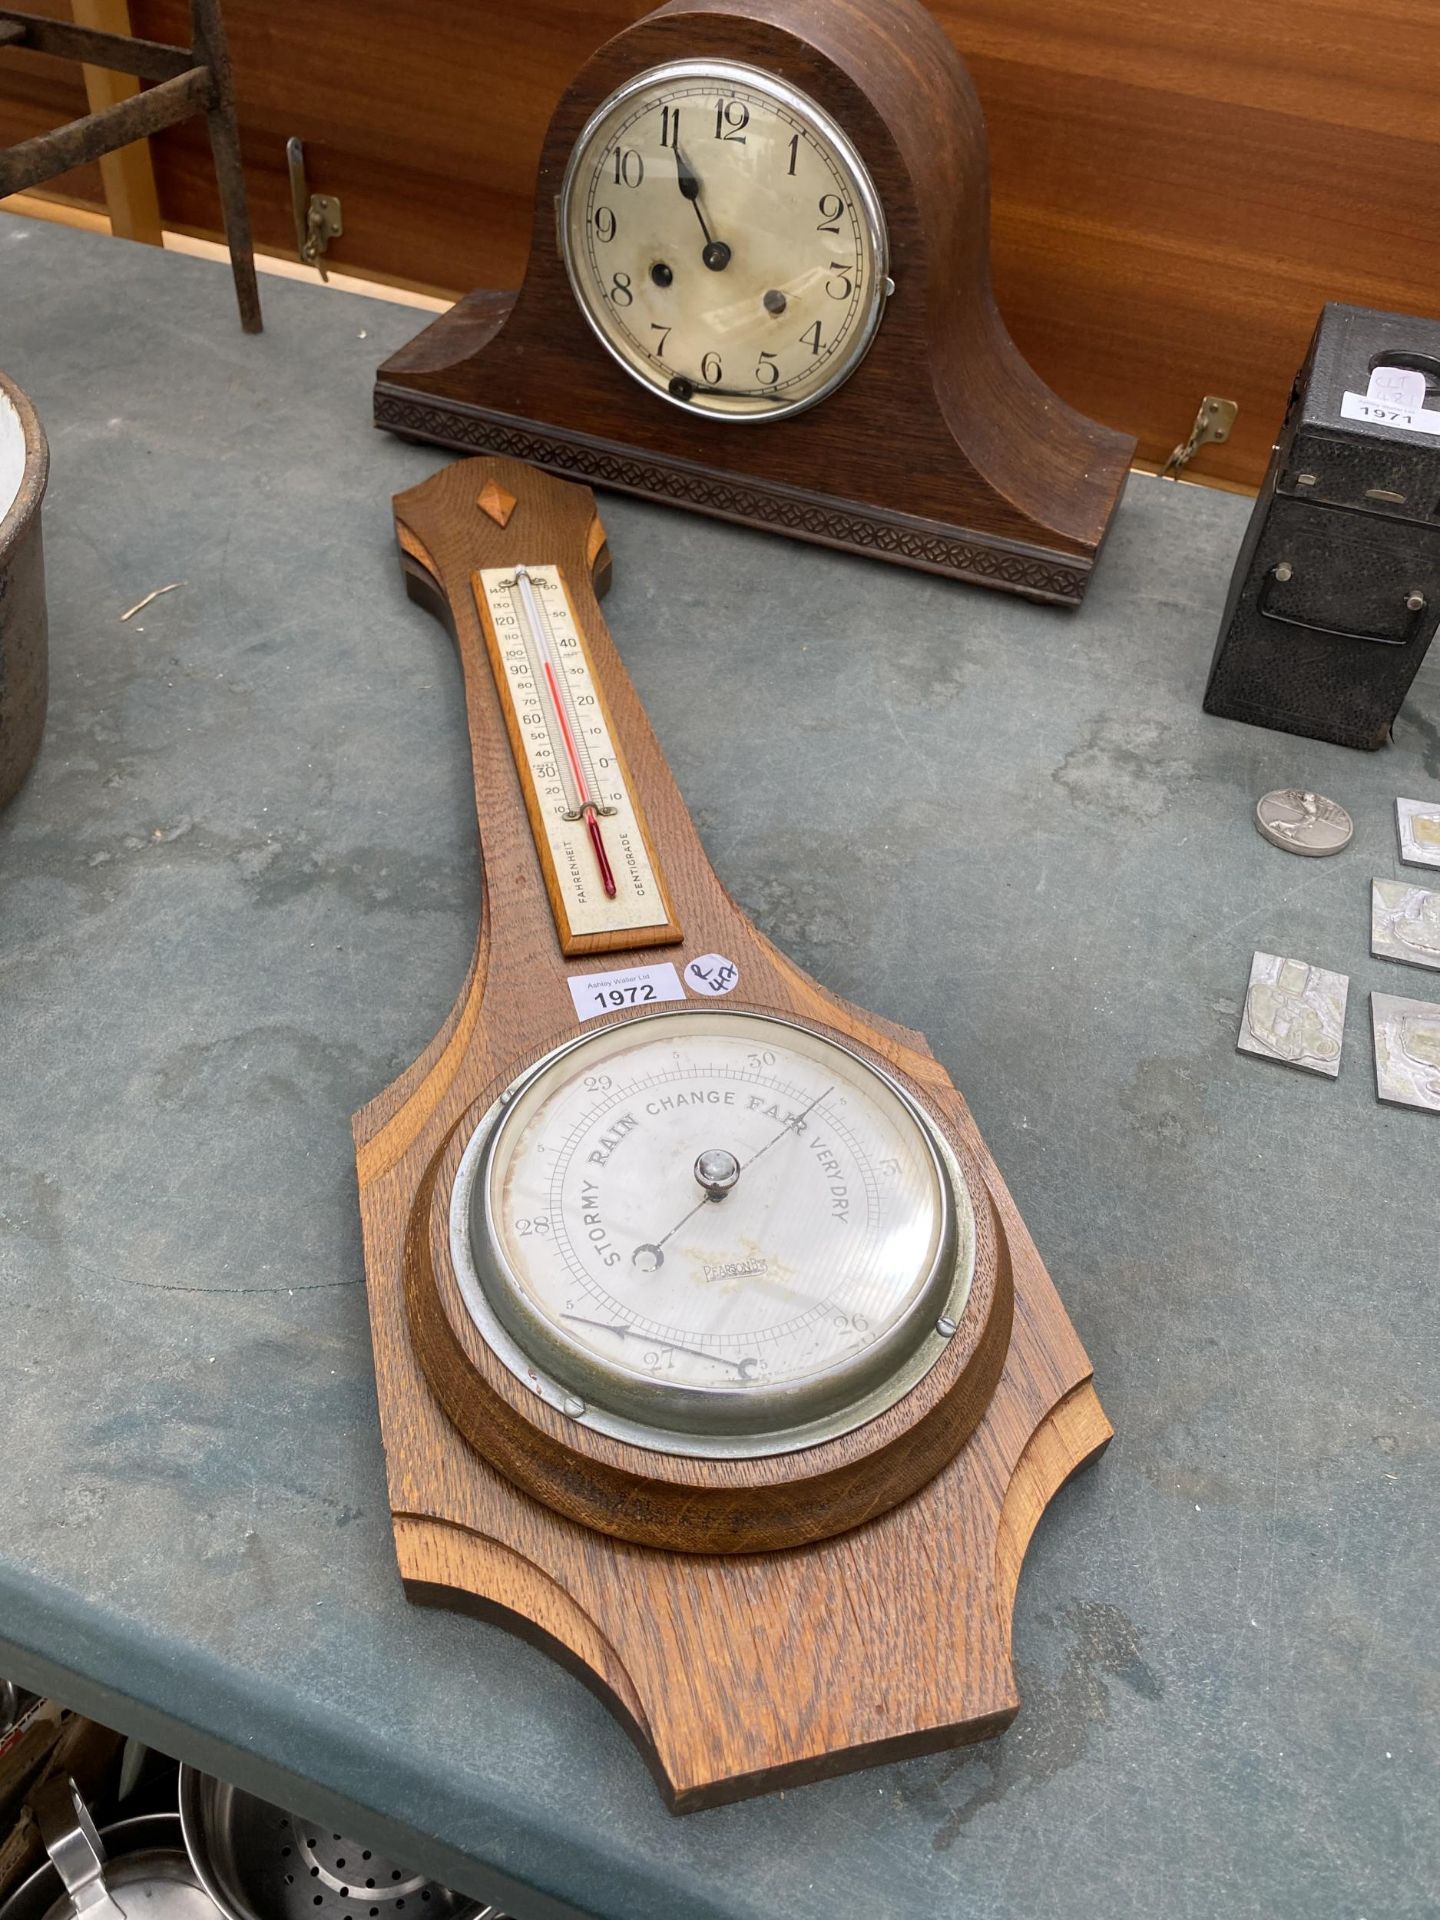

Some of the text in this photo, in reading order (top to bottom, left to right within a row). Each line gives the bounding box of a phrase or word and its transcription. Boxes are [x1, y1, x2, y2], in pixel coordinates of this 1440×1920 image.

[659, 106, 680, 149] 11
[714, 98, 749, 144] 12
[787, 134, 799, 176] 1
[613, 146, 643, 189] 10
[594, 207, 616, 243] 9
[816, 194, 844, 234] 2
[610, 272, 633, 307] 8
[825, 262, 852, 300] 3
[651, 324, 672, 357] 7
[799, 320, 827, 355] 4
[701, 352, 722, 384] 6
[755, 352, 779, 385] 5
[1360, 406, 1412, 424] 1971
[495, 616, 515, 626] 120
[505, 633, 519, 641] 110
[560, 638, 577, 648] 40
[510, 664, 528, 676] 90
[570, 667, 584, 675] 30
[517, 681, 533, 690] 80
[523, 698, 537, 706] 70
[576, 695, 595, 706] 20
[522, 713, 541, 725] 60
[530, 732, 546, 741] 50
[589, 727, 602, 735] 10
[535, 750, 551, 758] 40
[599, 757, 609, 769] 0
[536, 766, 556, 778] 30
[545, 786, 560, 795] 20
[609, 792, 622, 801] 10
[553, 805, 566, 814] 10
[563, 840, 587, 904] FAHRENHEIT
[619, 832, 645, 896] CENTIGRADE
[587, 976, 612, 990] Ashley
[690, 963, 713, 981] R
[594, 984, 658, 1009] 1972
[747, 1051, 776, 1068] 30
[583, 1075, 612, 1092] 29
[646, 1090, 736, 1115] CHANGE
[746, 1095, 808, 1137] FAIR
[588, 1112, 640, 1168] RAIN
[809, 1136, 849, 1225] VERY DRY
[515, 1215, 550, 1237] 28
[582, 1179, 622, 1268] STORMY
[833, 1311, 870, 1336] 26
[643, 1348, 676, 1372] 27
